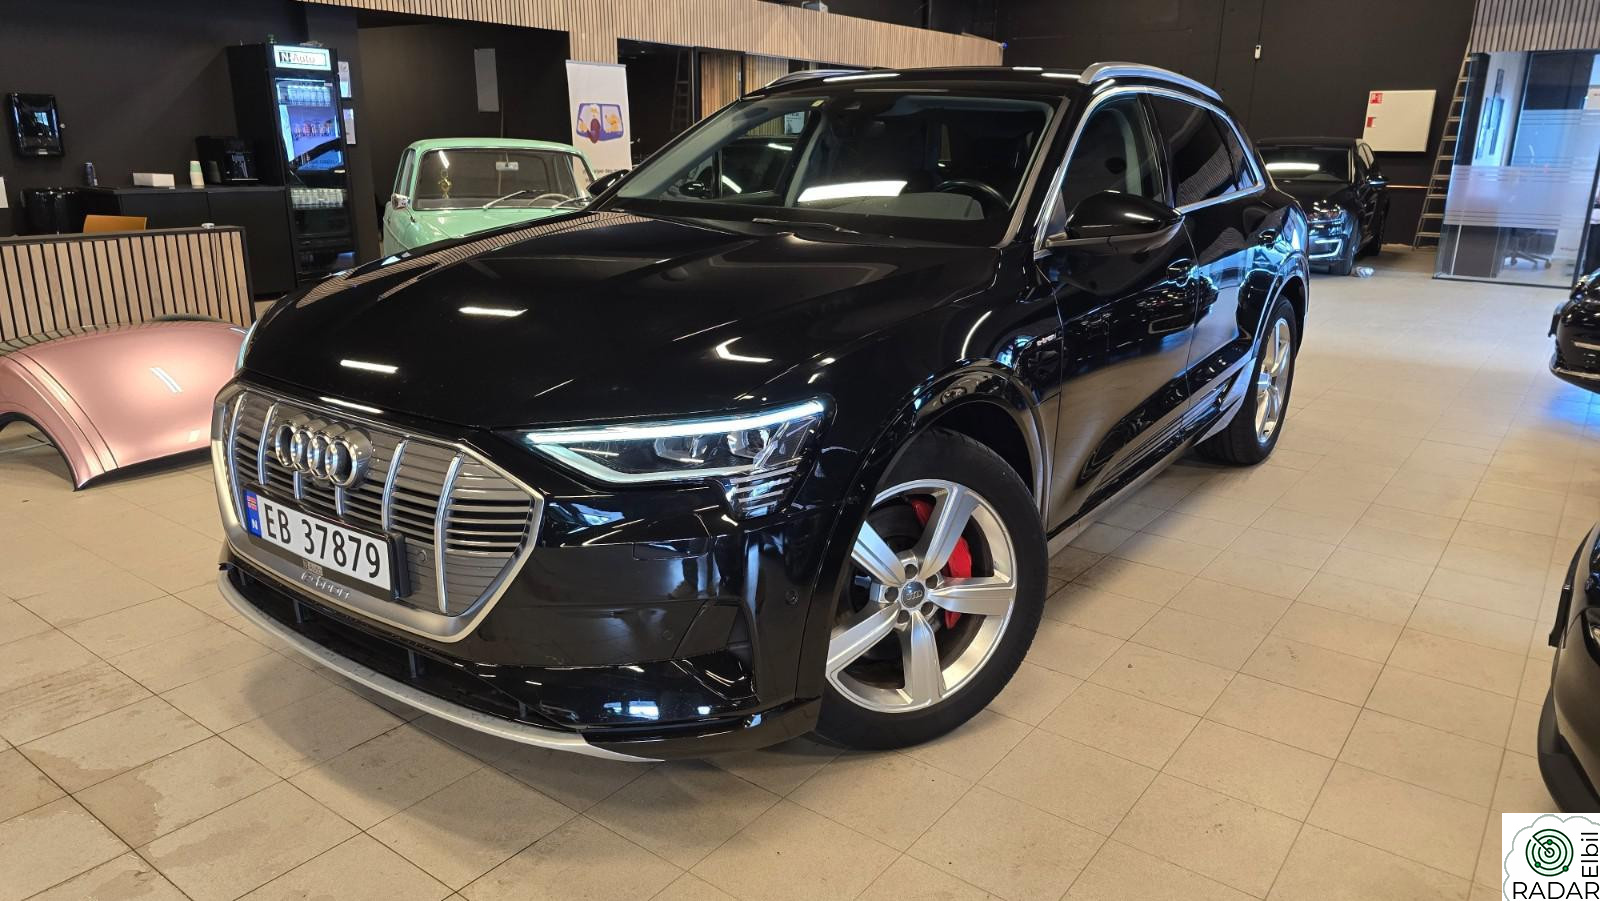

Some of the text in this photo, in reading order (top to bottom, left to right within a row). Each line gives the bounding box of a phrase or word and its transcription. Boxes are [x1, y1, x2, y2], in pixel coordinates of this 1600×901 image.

[251, 518, 259, 530] N
[263, 502, 381, 579] EB 37879
